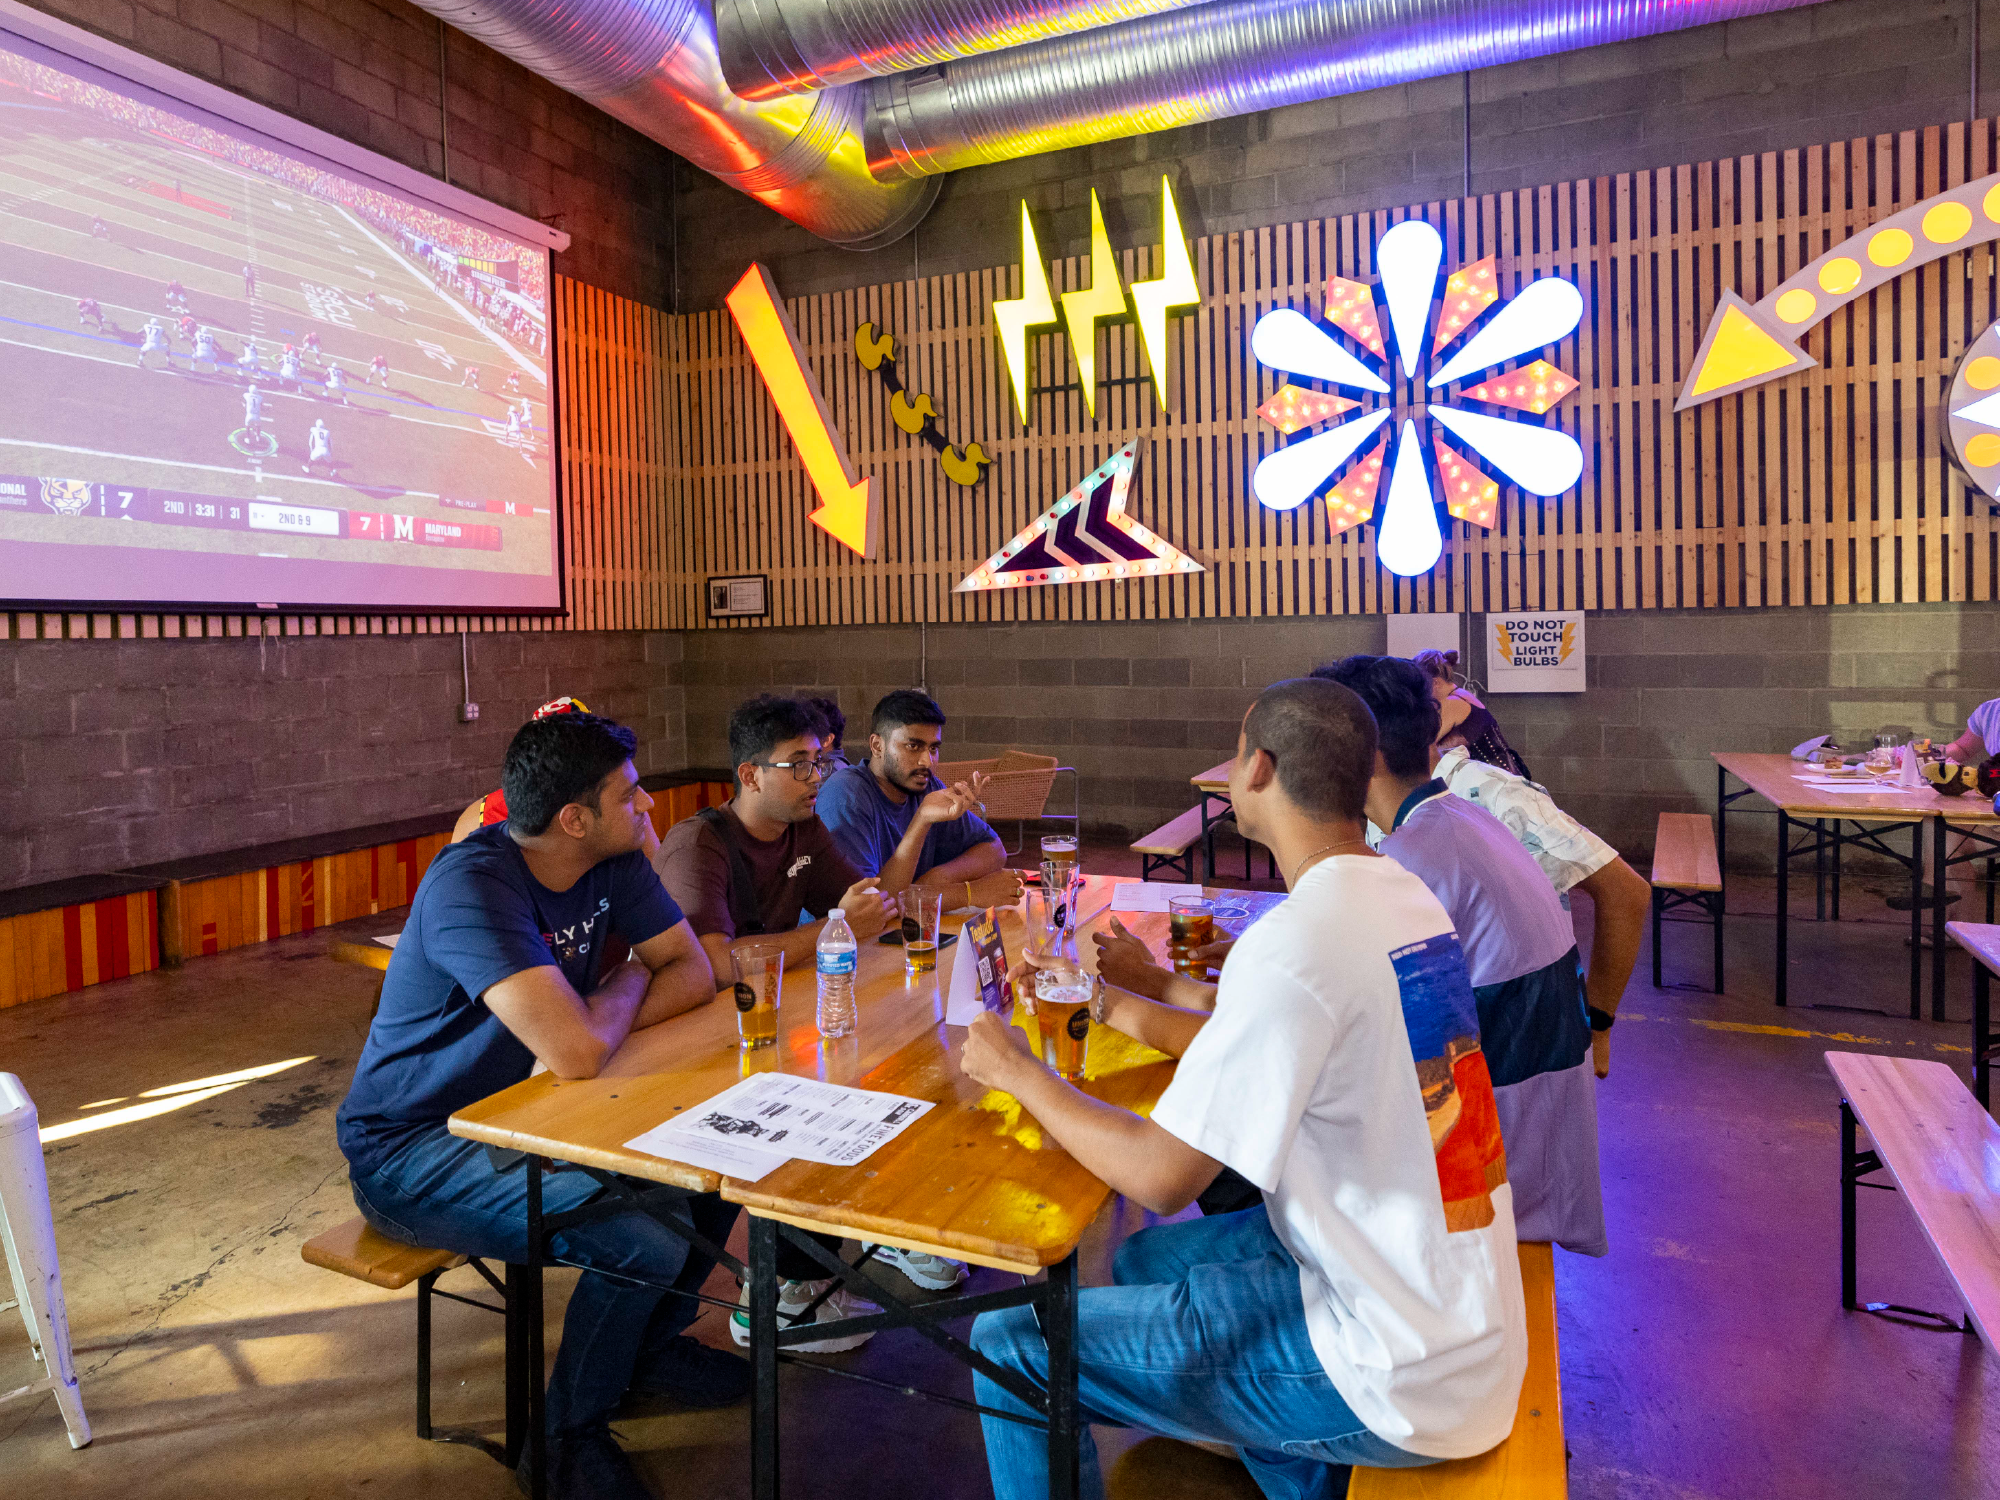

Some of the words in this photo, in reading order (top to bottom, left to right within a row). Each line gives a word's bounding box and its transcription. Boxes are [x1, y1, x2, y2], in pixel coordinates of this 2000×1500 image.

[0, 482, 27, 496] ONAL
[117, 491, 134, 509] 7
[455, 499, 477, 509] PRE-PLAY
[163, 500, 185, 515] 2ND
[195, 503, 216, 518] 3:31
[229, 506, 241, 520] 31
[504, 501, 516, 515] M
[278, 512, 296, 525] 2ND
[359, 517, 371, 531] 7
[393, 514, 414, 542] M
[424, 523, 462, 538] MARYLAND
[1506, 620, 1529, 631] DO
[1533, 619, 1566, 630] NOT
[1508, 632, 1563, 643] TOUCH
[1515, 645, 1557, 656] LIGHT
[1513, 656, 1559, 667] BULBS
[869, 1124, 895, 1140] FINE
[840, 1139, 876, 1161] FOODS
